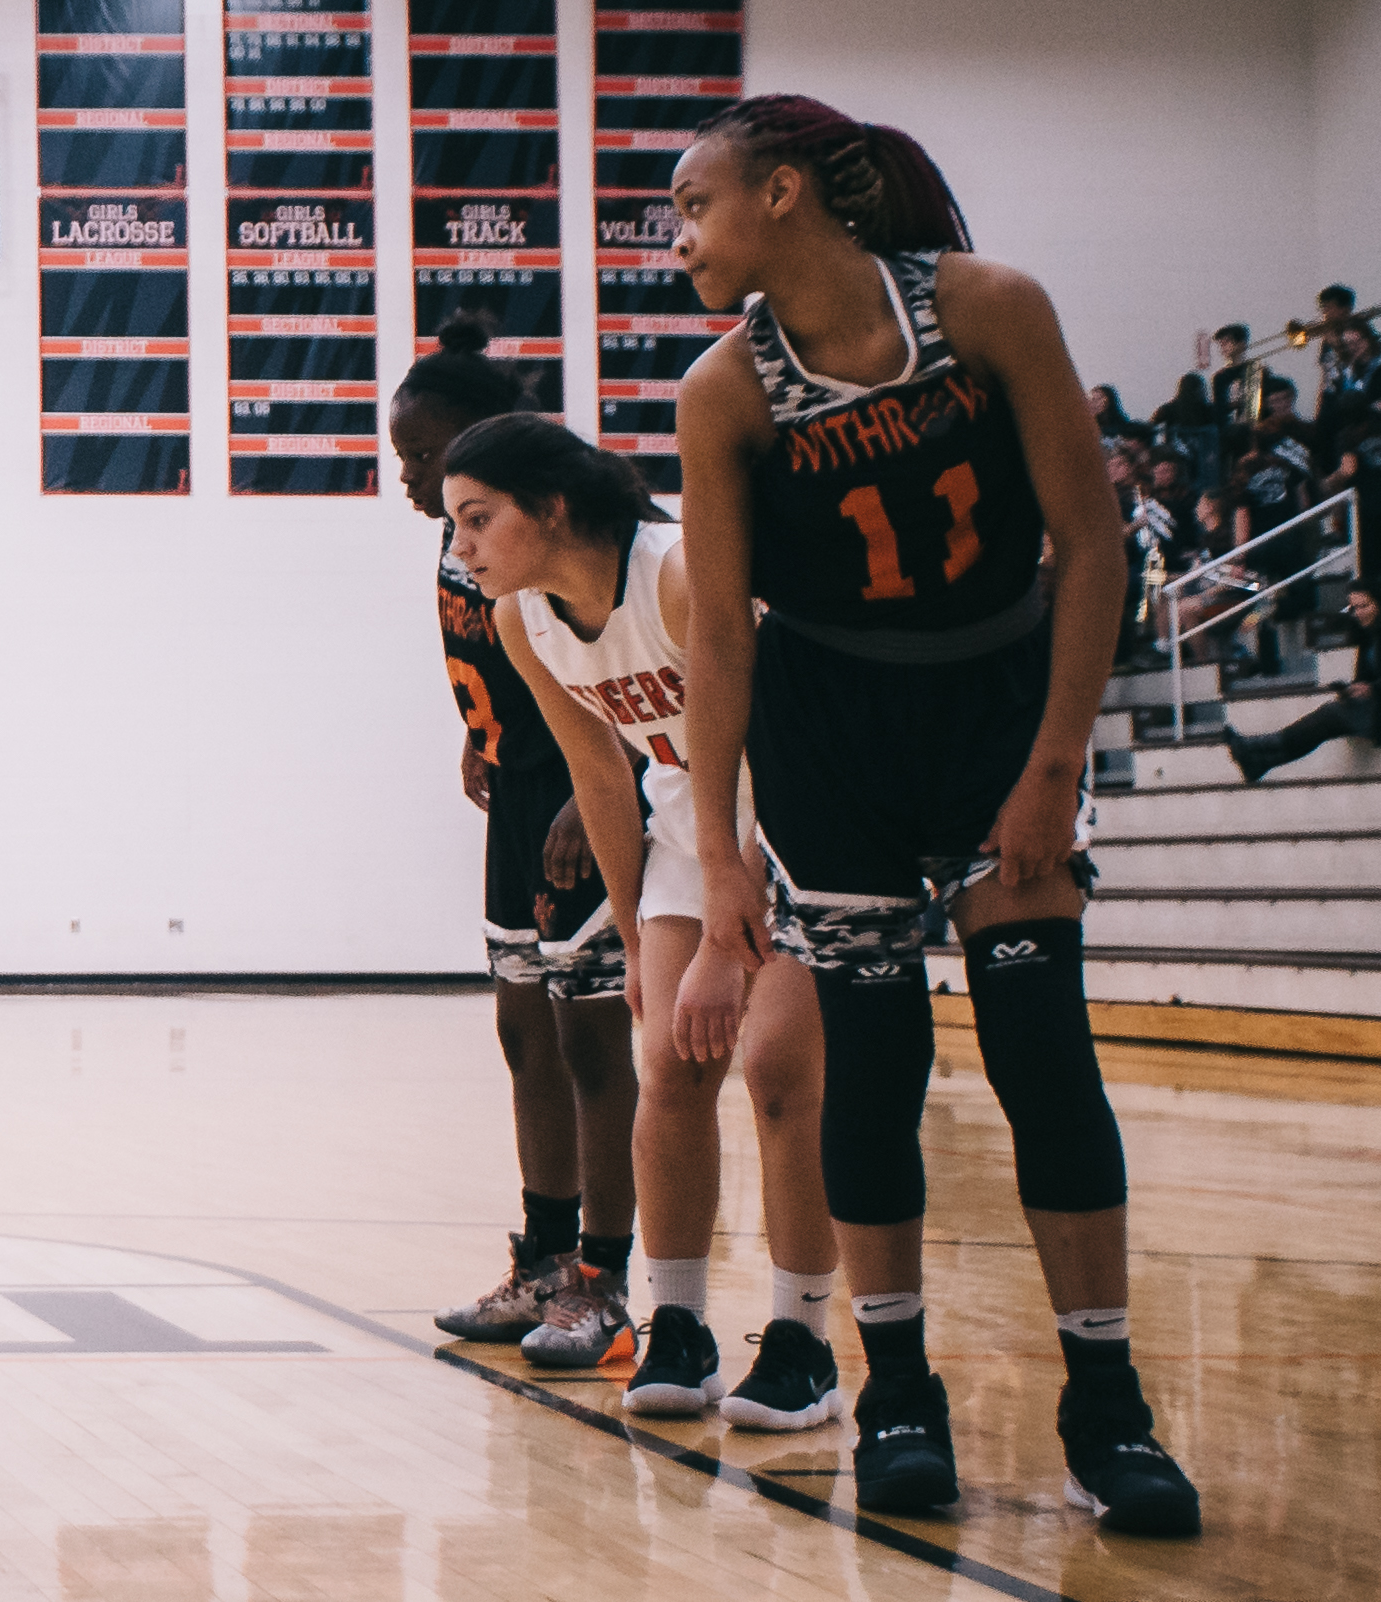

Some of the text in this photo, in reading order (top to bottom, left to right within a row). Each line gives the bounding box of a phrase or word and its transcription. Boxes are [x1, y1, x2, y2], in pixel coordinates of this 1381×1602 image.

[88, 204, 138, 220] GIRLS
[276, 204, 325, 220] GIRLS
[460, 204, 511, 220] GIRLS
[52, 220, 175, 244] LACROSSE
[239, 220, 363, 245] SOFTBALL
[447, 220, 527, 245] TRACK
[87, 251, 141, 267] LEAGUE
[261, 317, 342, 333] SECTIONAL
[81, 340, 149, 356] DISTRICT
[270, 383, 335, 399] DISTRICT
[80, 415, 151, 432] REGIONAL
[839, 461, 979, 600] 11
